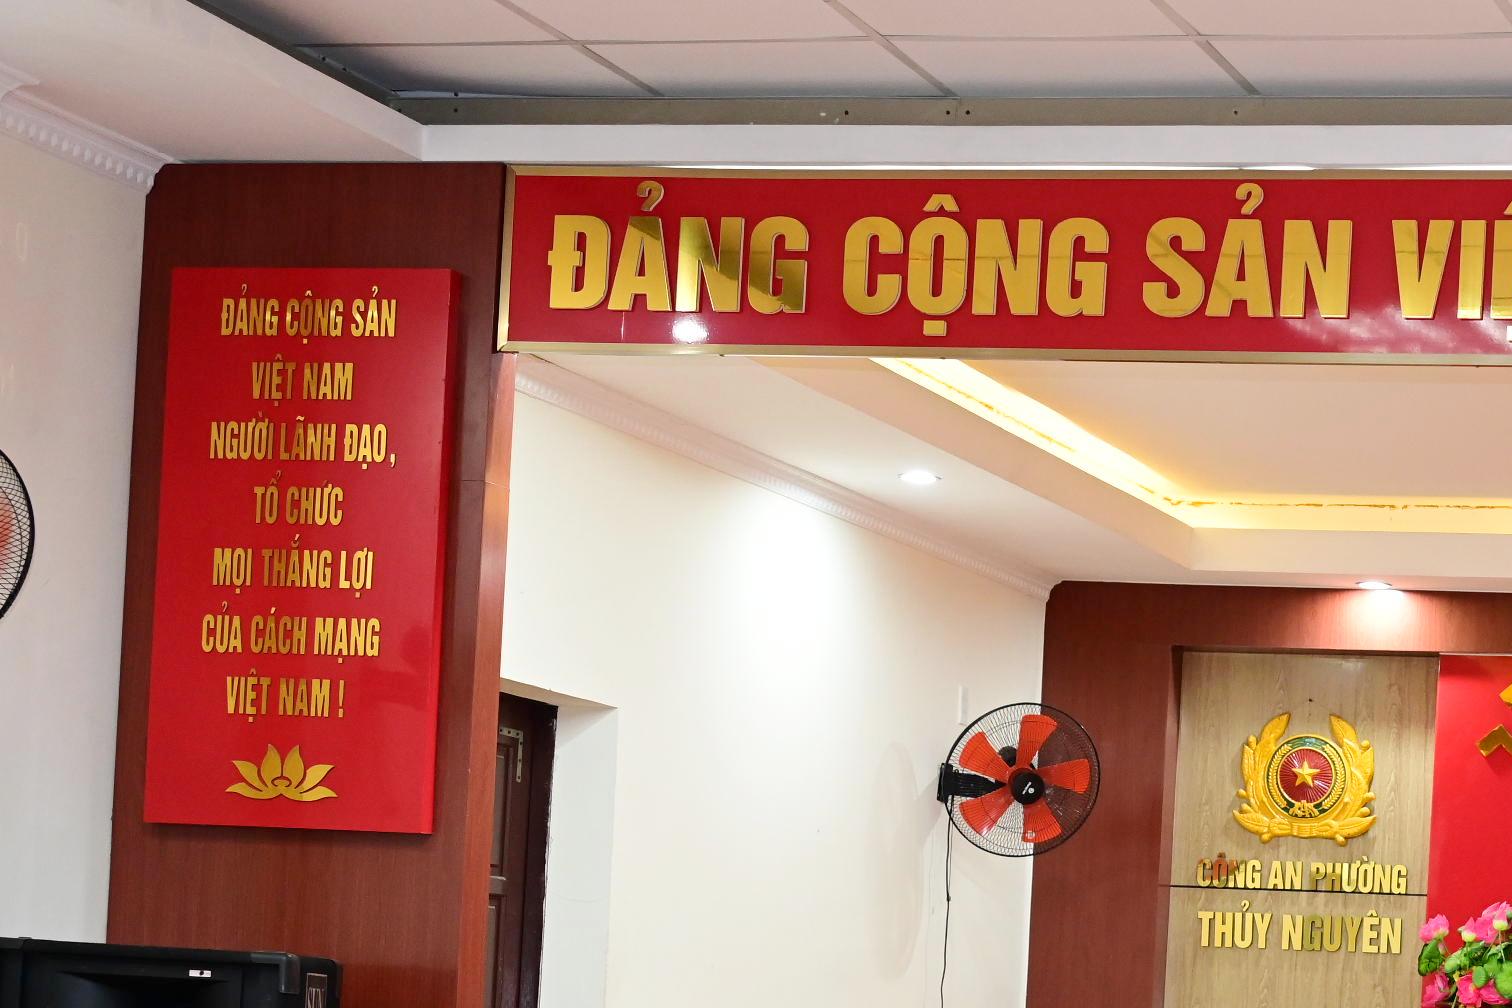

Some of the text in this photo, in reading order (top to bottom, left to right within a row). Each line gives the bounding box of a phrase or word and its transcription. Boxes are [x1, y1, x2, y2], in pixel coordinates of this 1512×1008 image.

[548, 180, 809, 314] ĐẢNG
[842, 193, 1108, 337] CỘNG
[1142, 182, 1352, 318] SẢN
[221, 283, 397, 345] ĐẢNG CỘNG SẢN
[251, 354, 353, 406] VIỆT NAM
[210, 411, 397, 470] NGƯỜI LÃNH ĐẠO,
[254, 470, 344, 526] TỔ CHỨC
[213, 534, 375, 599] MỌI THẮNG LỢI
[201, 601, 380, 664] CỦA CÁCH MẠNG
[226, 668, 272, 722] VIỆT
[278, 678, 331, 717] NAM
[1197, 852, 1408, 894] CÔNG AN PHƯỜNG
[1198, 900, 1402, 954] THỦY NGUYÊN
